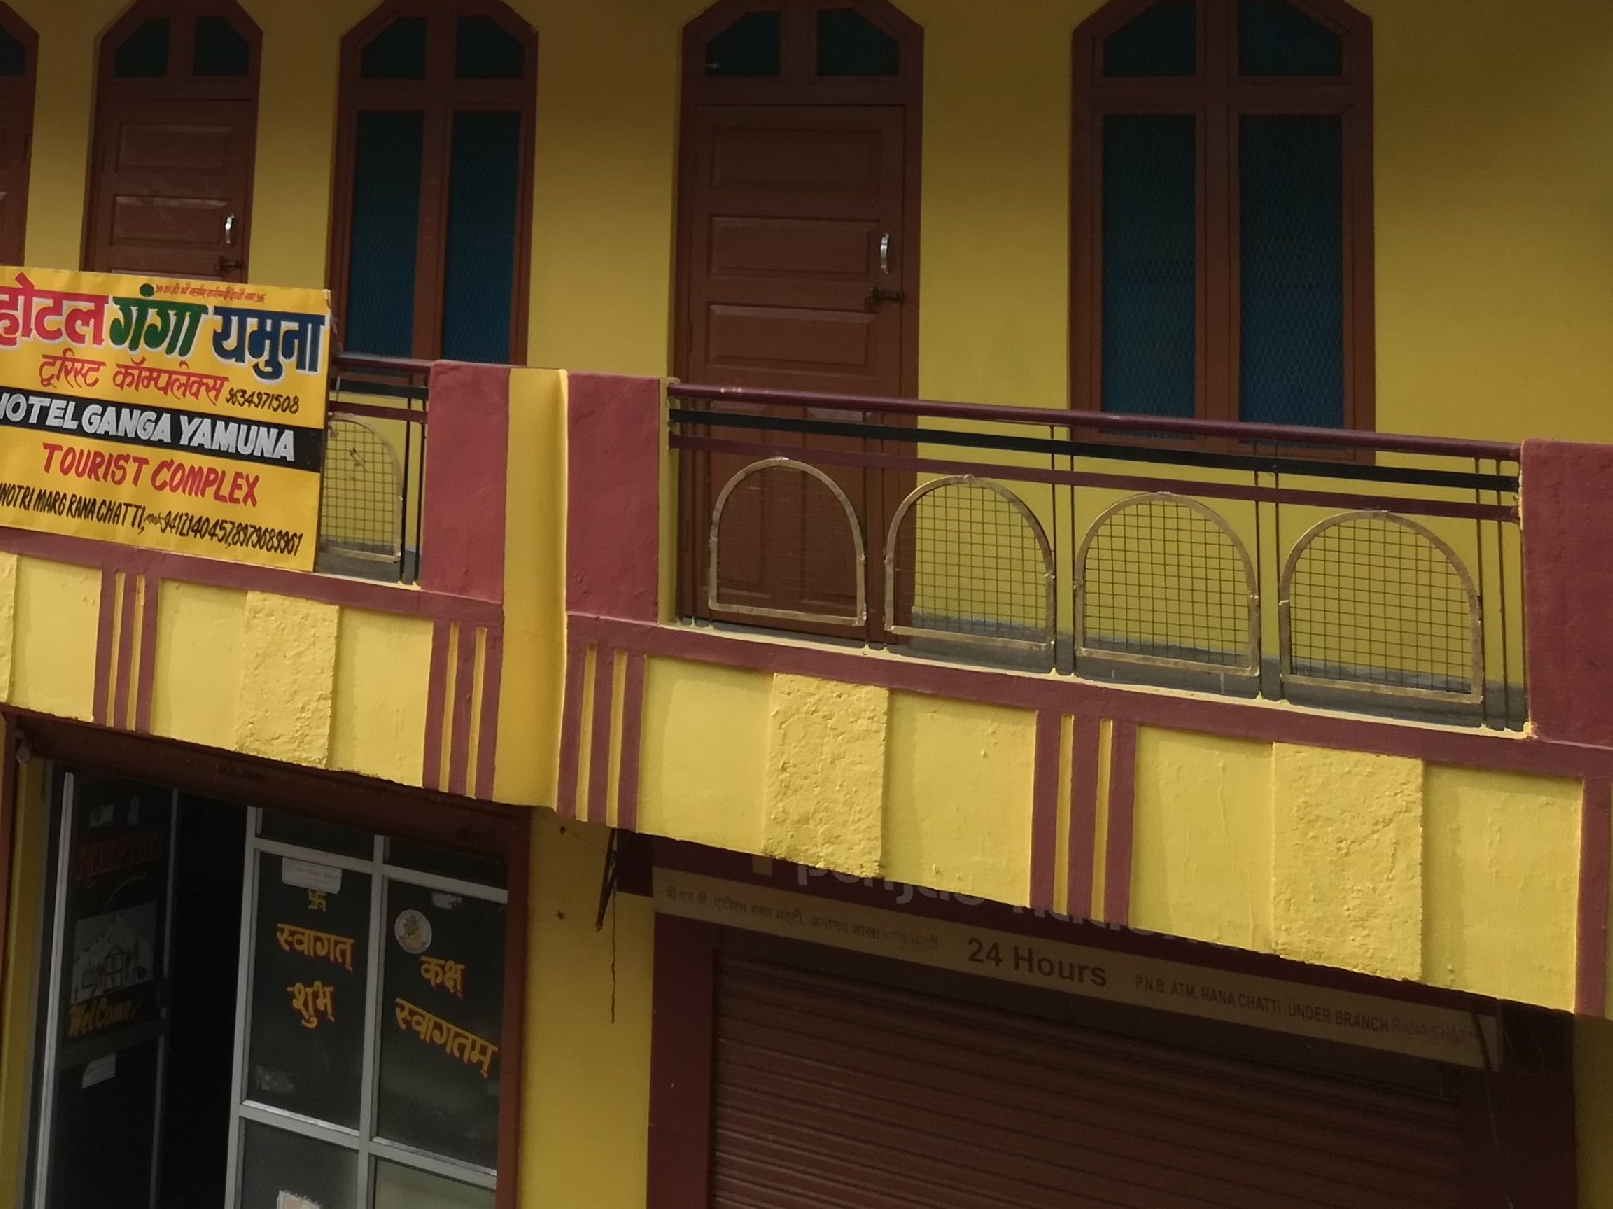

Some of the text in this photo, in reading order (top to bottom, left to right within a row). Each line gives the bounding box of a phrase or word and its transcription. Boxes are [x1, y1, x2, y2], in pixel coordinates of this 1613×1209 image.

[109, 283, 209, 358] गंगा
[211, 305, 326, 381] यमुना
[81, 403, 172, 443] GANGA
[178, 414, 296, 462] YAMUNA
[42, 442, 260, 508] TOURIST COMPLEX
[66, 493, 98, 522] RANA
[966, 938, 1108, 988] 24 Hours
[1200, 986, 1236, 1008] RANA
[1237, 993, 1282, 1015] CHATTI
[1334, 1010, 1390, 1035] BRANCH
